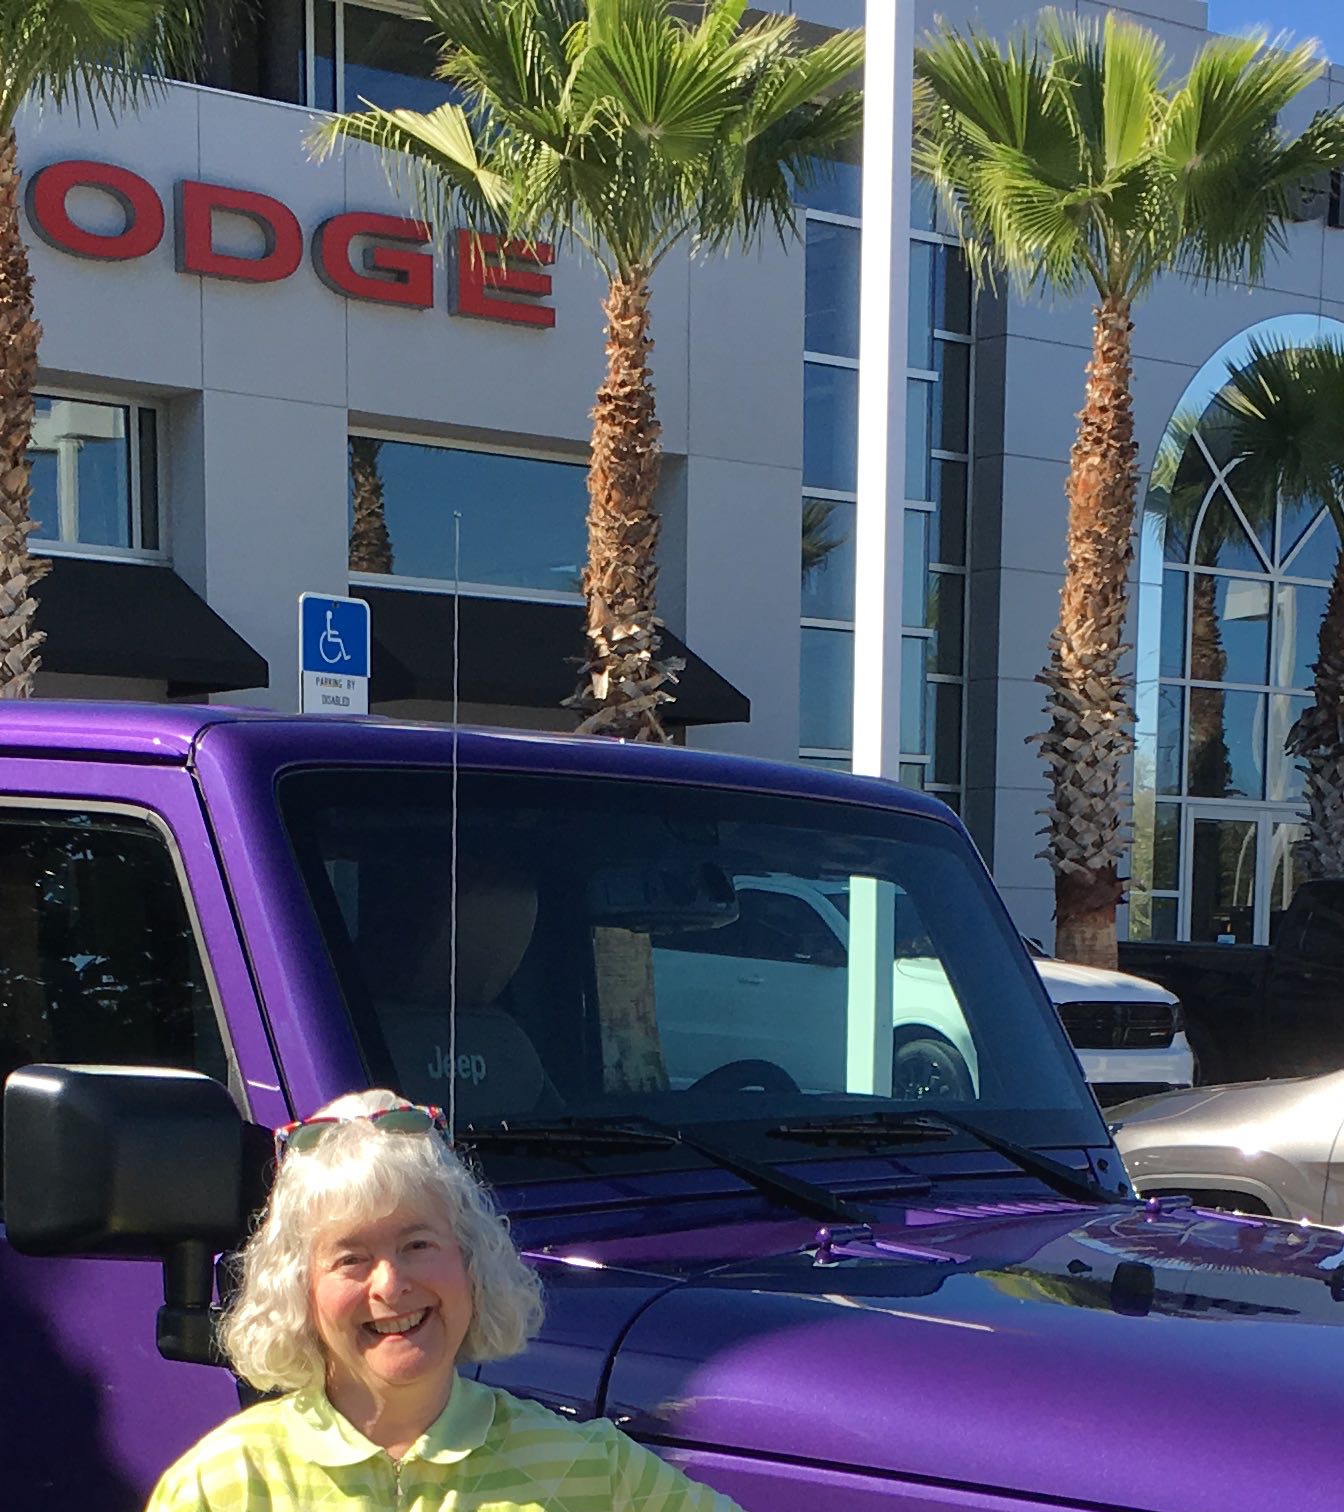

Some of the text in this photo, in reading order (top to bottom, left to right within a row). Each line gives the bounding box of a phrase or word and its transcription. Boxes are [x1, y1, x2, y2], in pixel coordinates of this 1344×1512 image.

[315, 676, 356, 691] PARKING BY
[321, 694, 351, 707] DISABLED
[427, 1045, 486, 1086] Jeep
